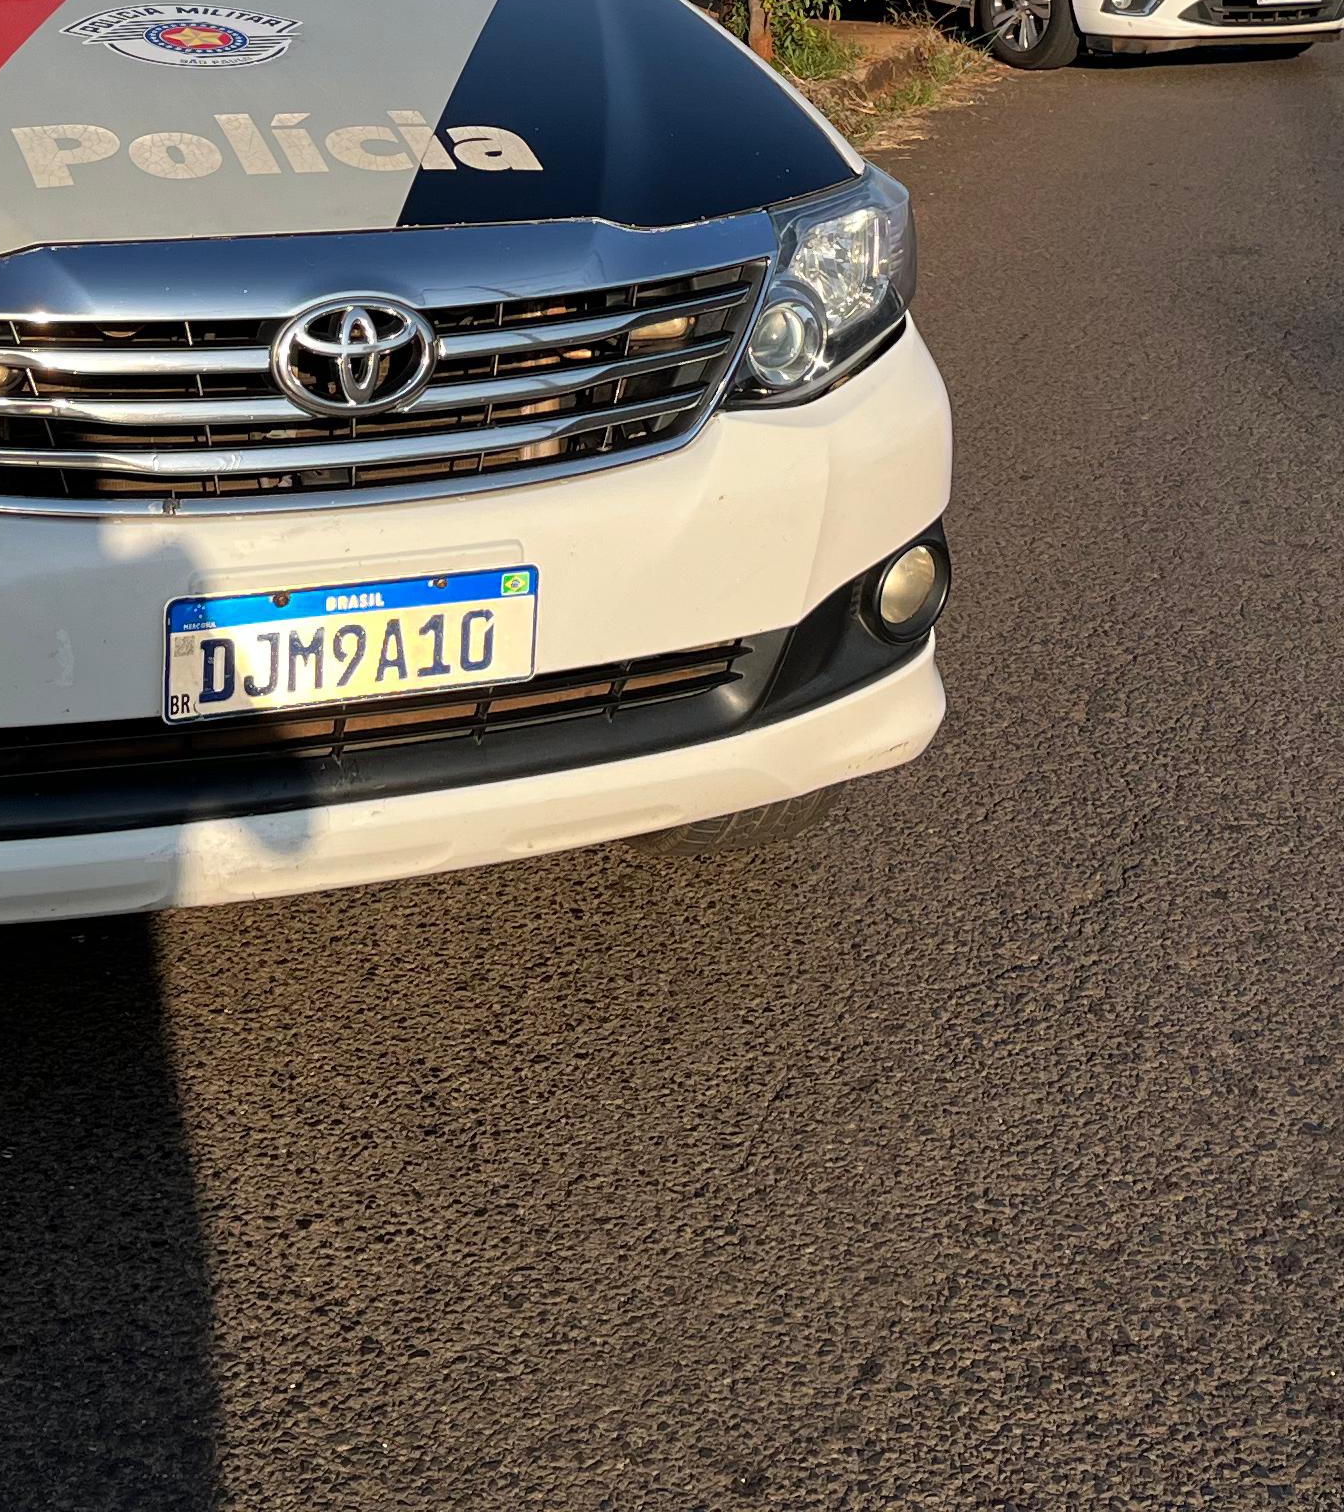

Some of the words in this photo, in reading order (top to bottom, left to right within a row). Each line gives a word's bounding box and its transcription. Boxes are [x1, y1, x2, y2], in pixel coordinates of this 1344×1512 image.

[175, 6, 282, 26] MILITAR
[10, 109, 544, 189] Polícia
[325, 592, 385, 612] BRASIL
[198, 608, 495, 705] DJM9A10
[170, 693, 191, 716] BR
